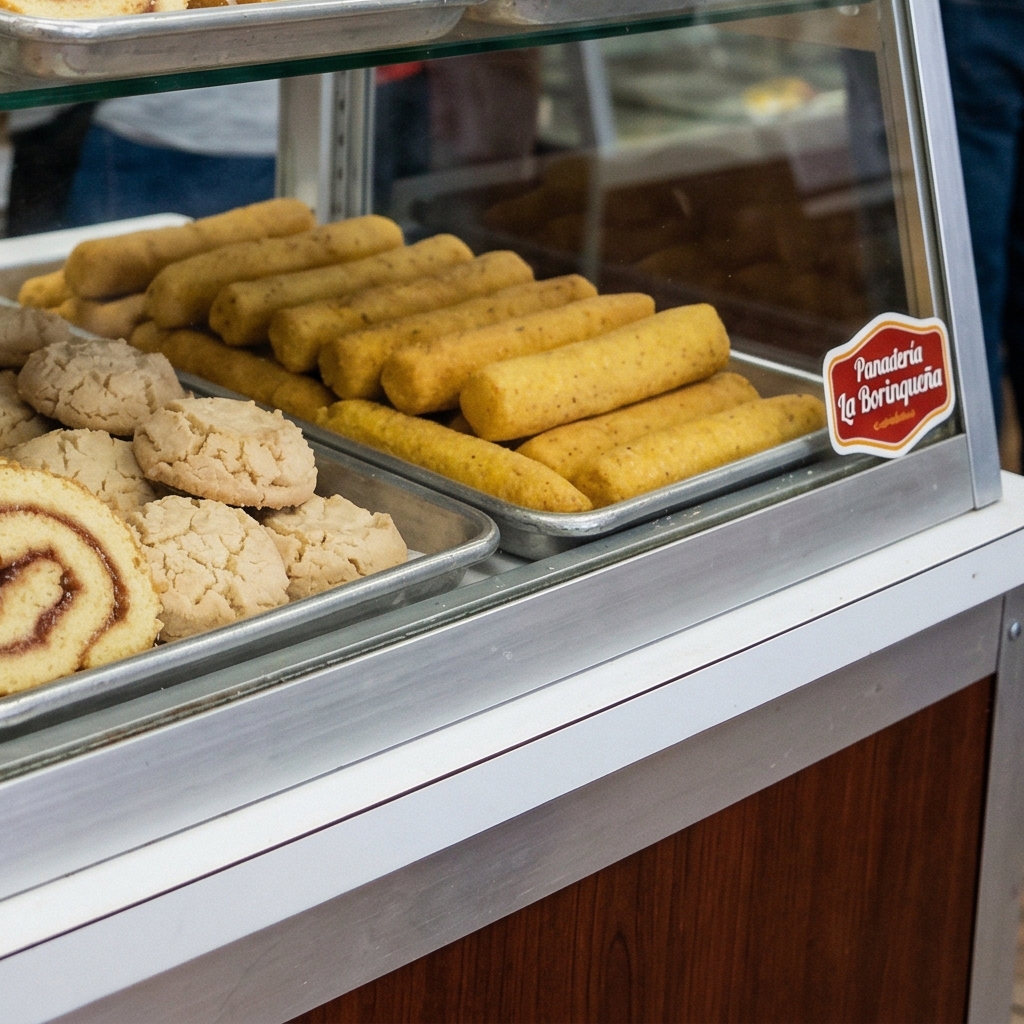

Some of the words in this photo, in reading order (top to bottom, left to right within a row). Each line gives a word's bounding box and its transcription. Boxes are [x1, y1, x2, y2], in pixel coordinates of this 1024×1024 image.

[854, 340, 923, 383] Panadería
[838, 392, 856, 426] La
[858, 365, 943, 414] Borinqueña
